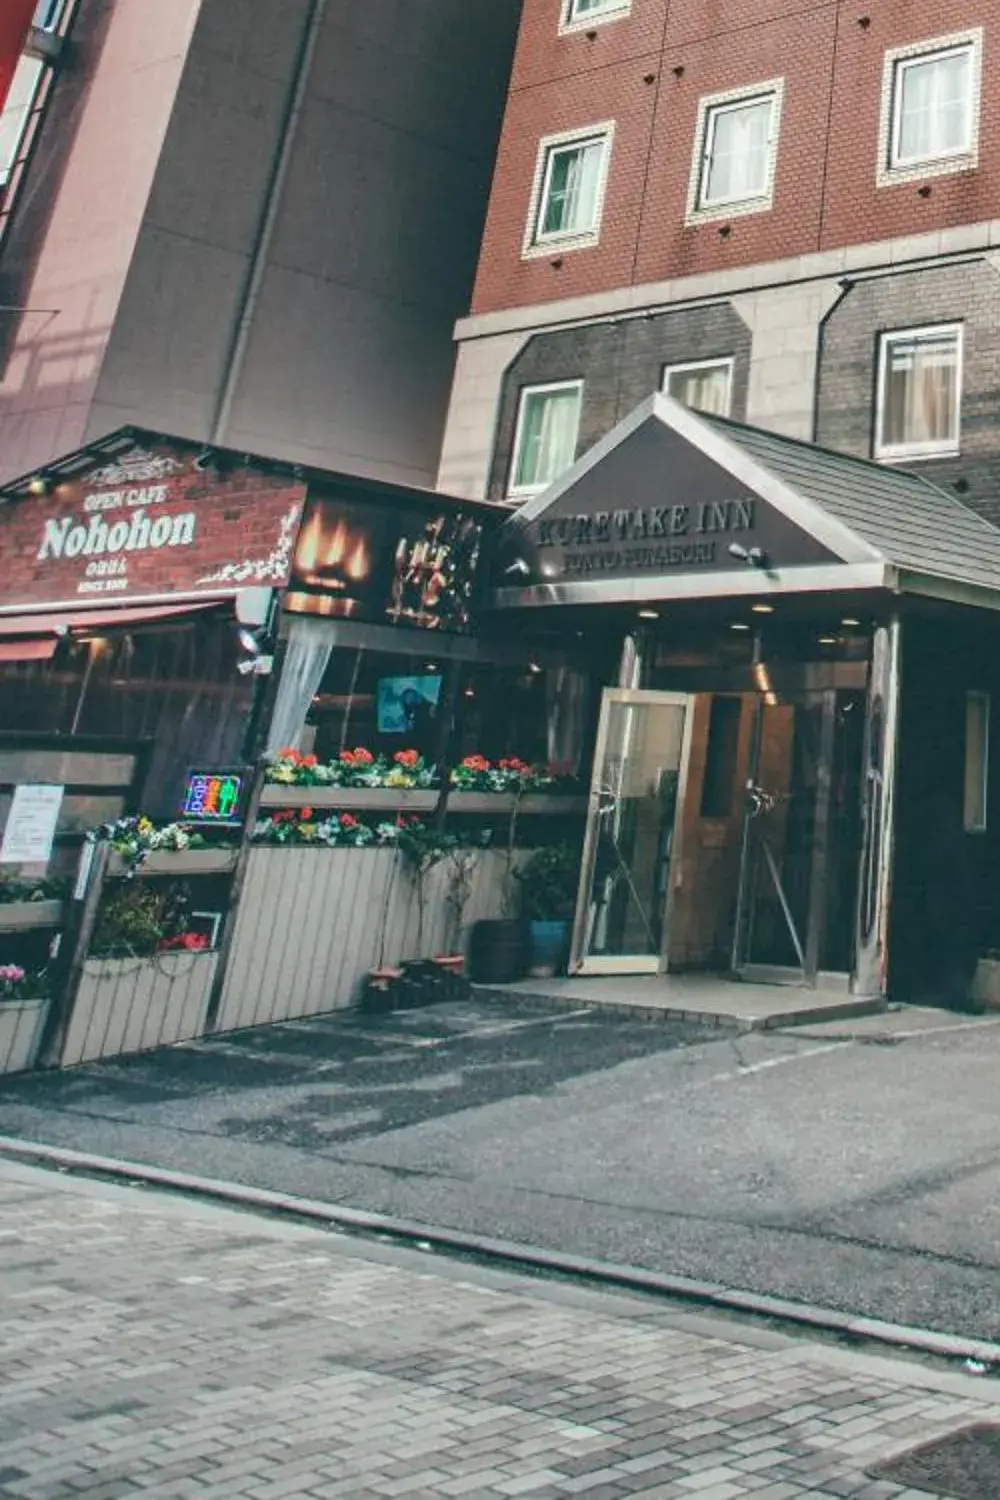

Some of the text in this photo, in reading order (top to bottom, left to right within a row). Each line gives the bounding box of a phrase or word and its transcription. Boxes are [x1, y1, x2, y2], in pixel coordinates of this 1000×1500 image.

[83, 492, 123, 512] OPEN
[536, 499, 756, 547] KURETAKE INN
[37, 509, 195, 560] Nohohon
